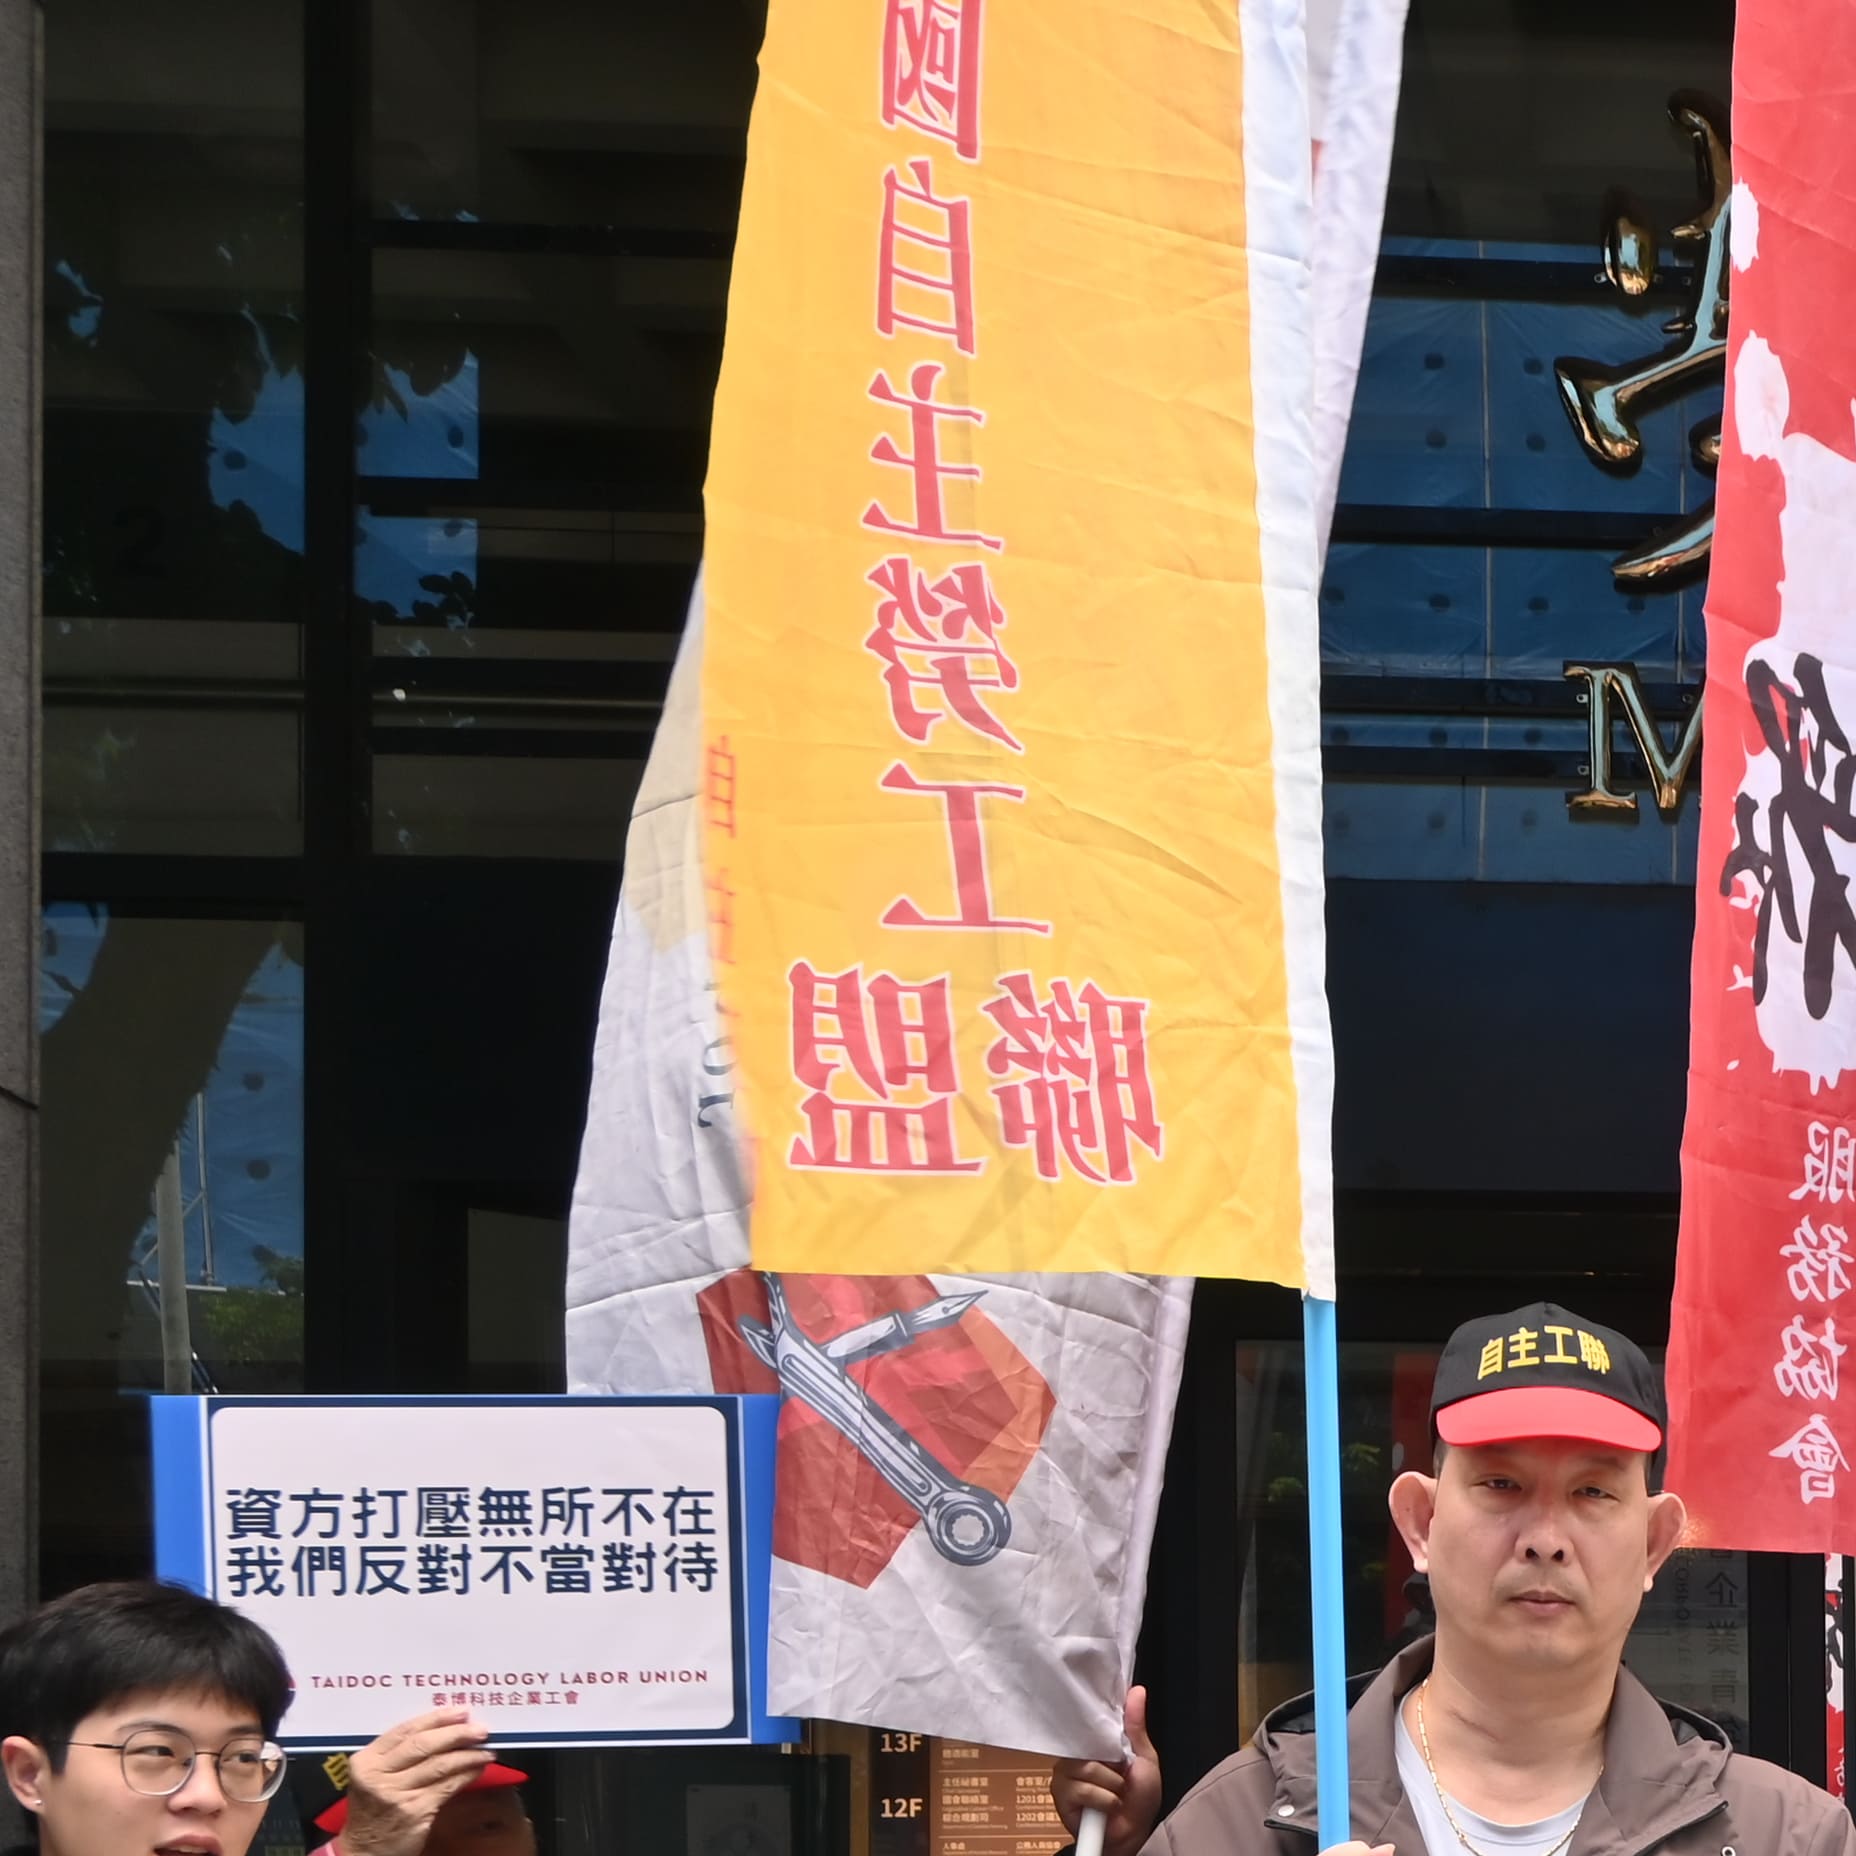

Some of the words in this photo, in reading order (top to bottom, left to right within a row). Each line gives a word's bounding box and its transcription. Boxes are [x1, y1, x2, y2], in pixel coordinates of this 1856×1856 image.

[1477, 1324, 1611, 1381] 自主工聯
[225, 1486, 718, 1541] 資方打壓無所不在
[226, 1542, 720, 1598] 我們反對不當對待
[311, 1674, 393, 1689] TAIDOC
[402, 1671, 549, 1688] TECHNOLOGY
[560, 1671, 630, 1686] LABOR
[639, 1669, 709, 1685] UNION
[431, 1690, 580, 1707] 泰博科技企業工會
[880, 1732, 922, 1753] 13F
[880, 1797, 922, 1819] 12F
